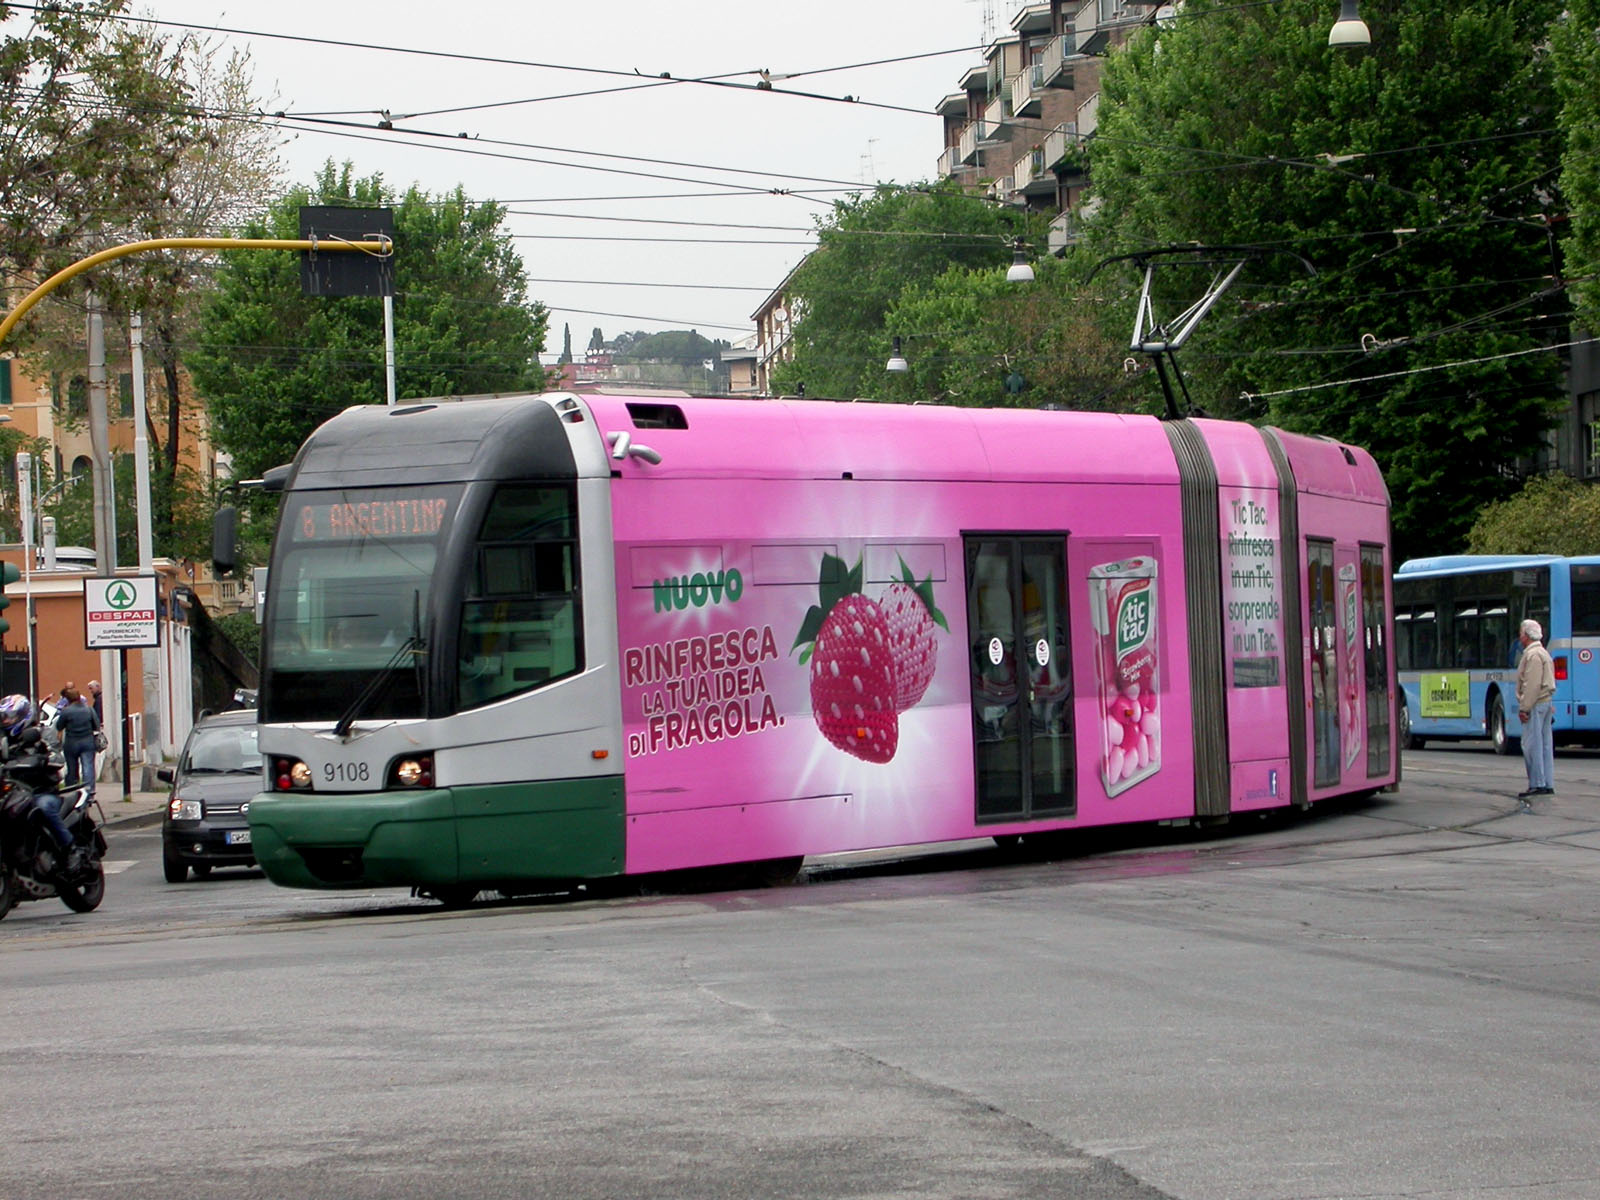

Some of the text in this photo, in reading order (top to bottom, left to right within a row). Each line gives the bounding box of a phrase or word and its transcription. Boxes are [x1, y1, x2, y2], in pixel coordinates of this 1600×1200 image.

[303, 505, 314, 538] 8
[1231, 499, 1269, 525] Tic Tac.
[1228, 531, 1274, 557] Rinfresca
[653, 568, 743, 613] NUOVO
[1231, 563, 1274, 591] in un Tic,
[92, 611, 152, 621] DESPAR
[1127, 597, 1146, 623] tic
[1228, 595, 1279, 626] sorprende
[1122, 620, 1146, 643] tac
[1233, 627, 1242, 651] in
[1243, 633, 1256, 651] un
[1257, 628, 1278, 651] Tac.
[625, 625, 778, 687] RINFRESCA
[643, 665, 766, 715] LA TUA IDEA
[629, 694, 786, 757] DI FRAGOLA.
[324, 762, 369, 782] 9108
